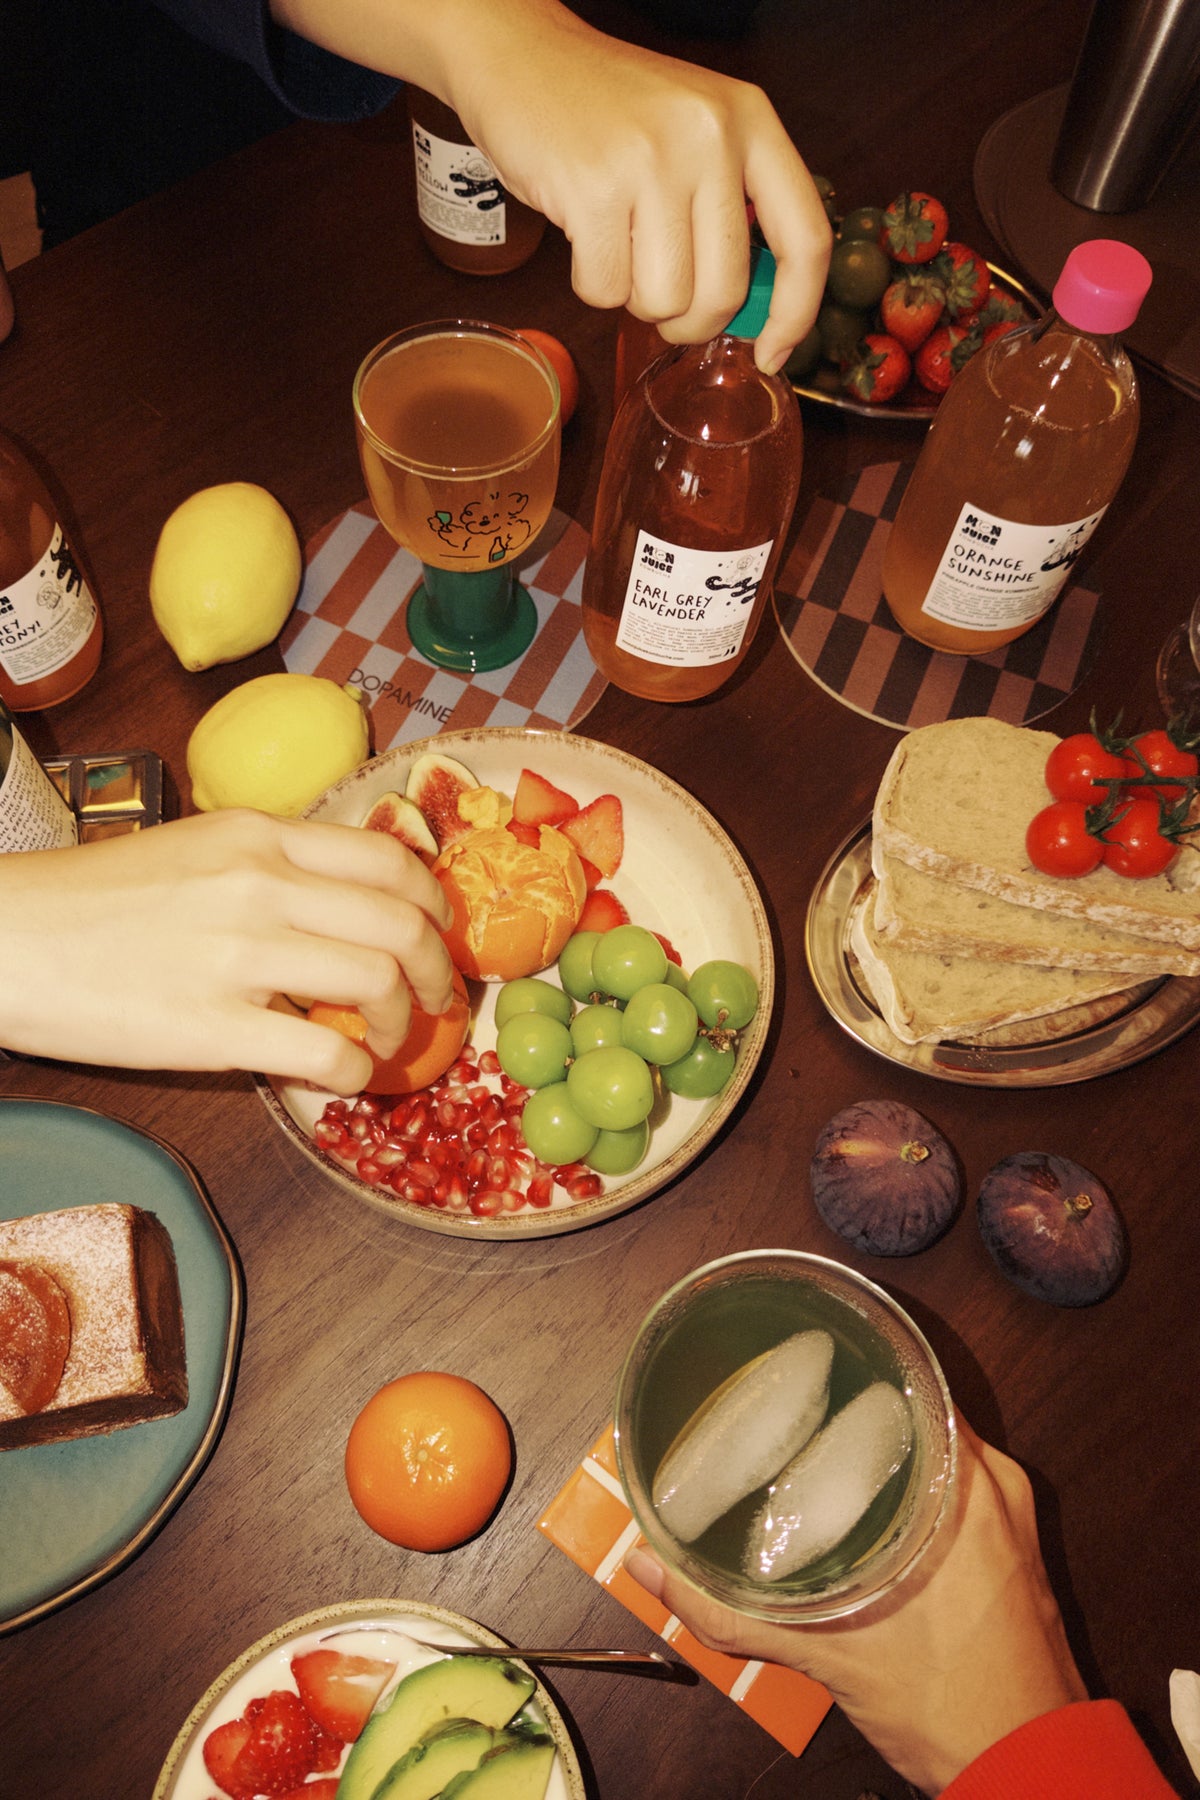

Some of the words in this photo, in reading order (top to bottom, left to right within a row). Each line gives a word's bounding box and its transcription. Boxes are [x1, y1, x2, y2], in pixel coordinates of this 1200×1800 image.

[962, 527, 998, 546] JUICE
[641, 556, 673, 573] JUICE
[948, 558, 1037, 583] SUNSHINE
[954, 545, 1024, 571] ORANGE
[632, 593, 706, 621] LAVENDER
[635, 579, 669, 603] EARL
[676, 594, 713, 609] GREY
[347, 668, 454, 724] DOPAMINE
